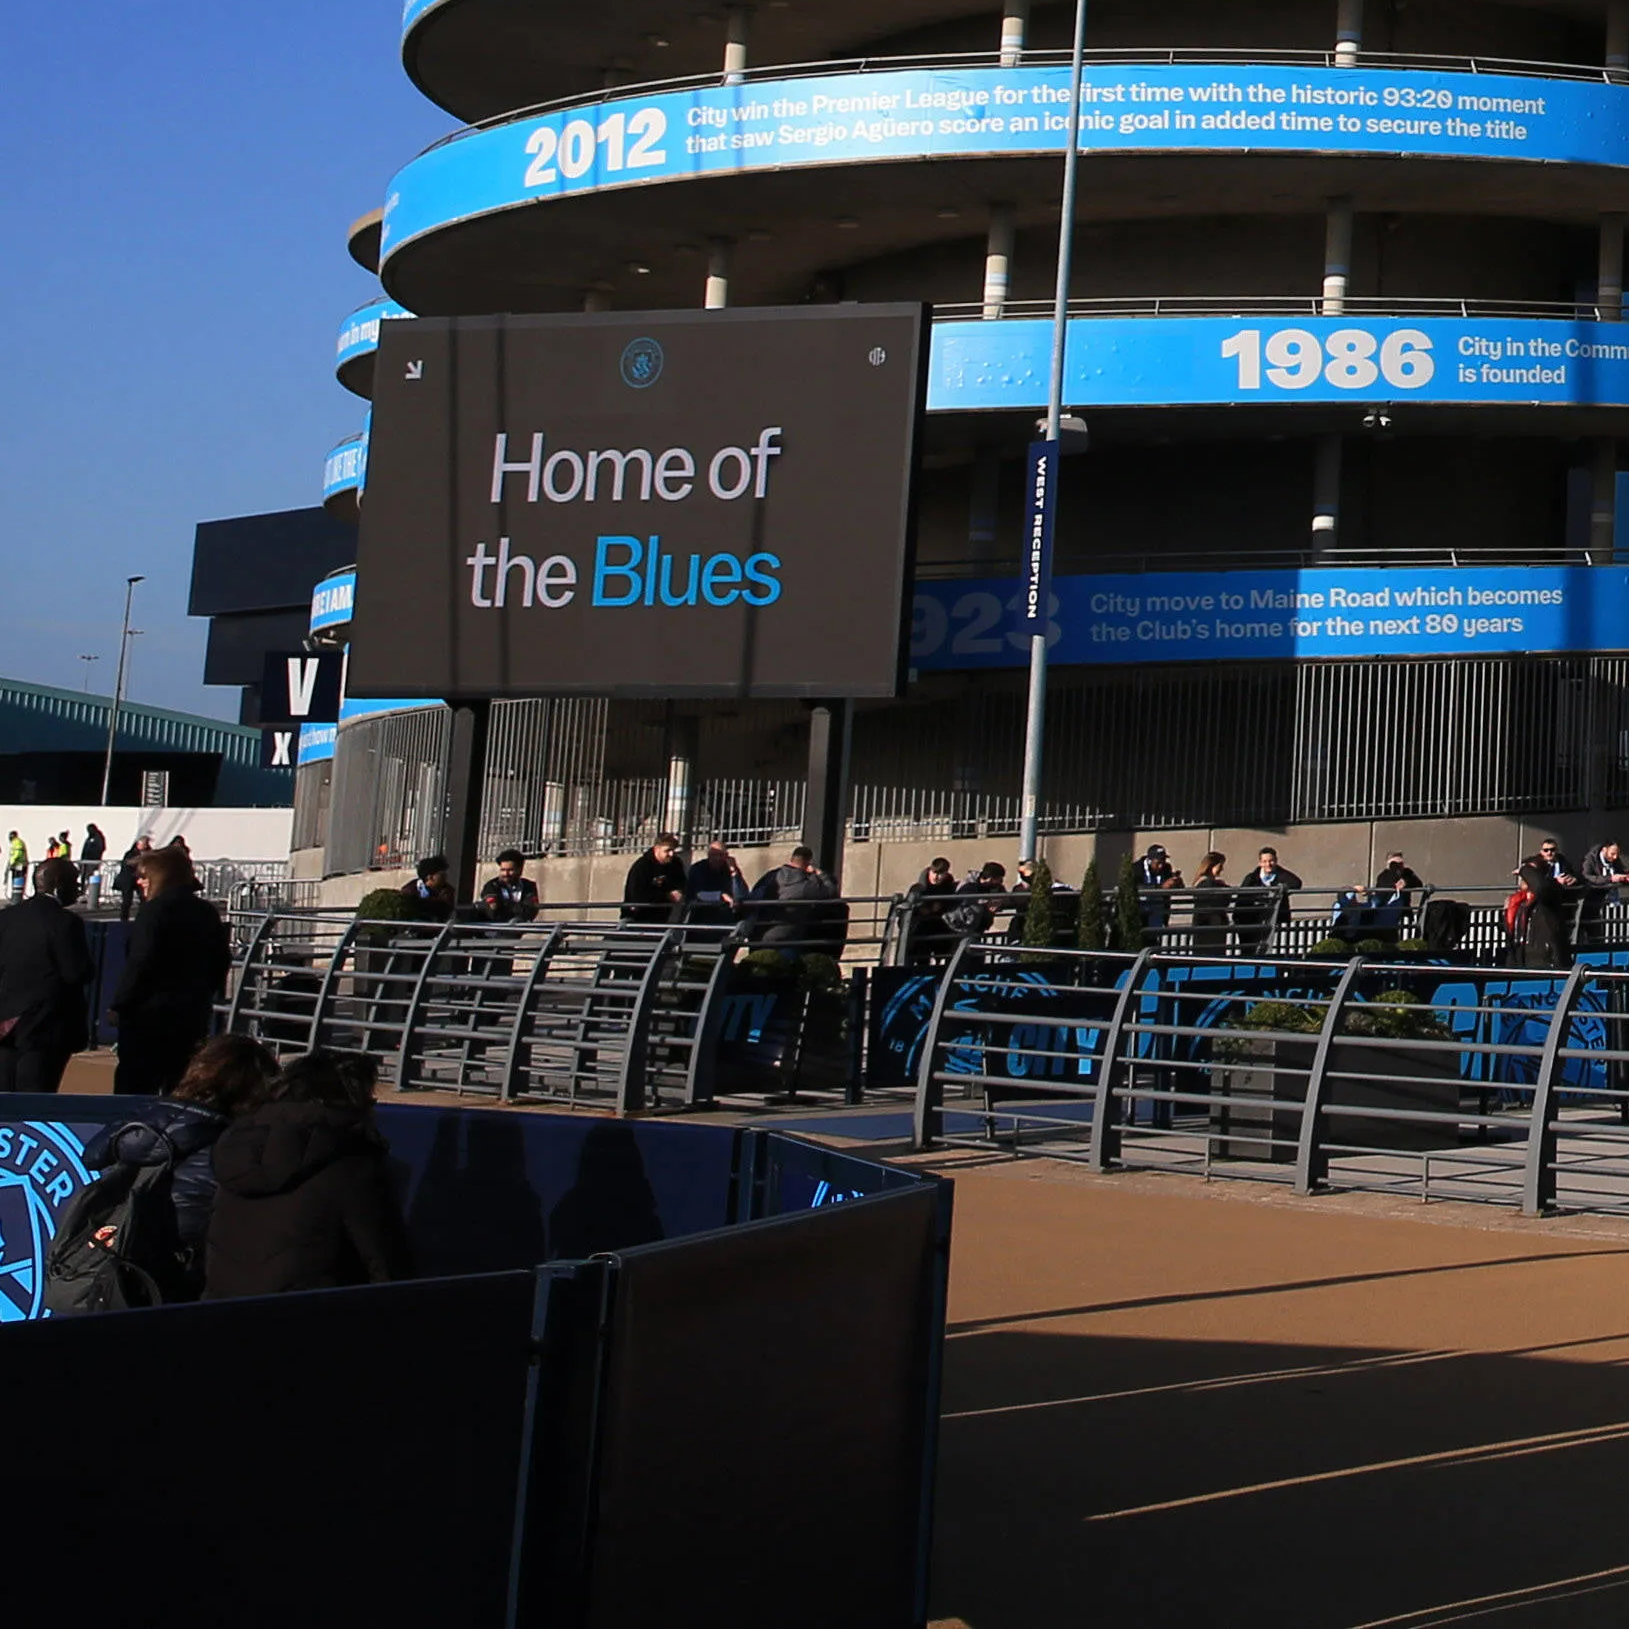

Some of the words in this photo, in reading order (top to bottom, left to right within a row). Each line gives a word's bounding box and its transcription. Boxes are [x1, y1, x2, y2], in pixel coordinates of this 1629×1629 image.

[685, 134, 726, 154] that
[730, 131, 774, 149] saw
[778, 121, 847, 147] Sergio
[851, 117, 934, 142] Agüero
[939, 116, 1004, 135] score
[1009, 114, 1039, 132] an
[1119, 109, 1169, 134] goal
[1174, 109, 1196, 130] in
[1201, 110, 1276, 131] added
[1280, 111, 1333, 132] time
[1337, 113, 1361, 133] to
[1366, 117, 1441, 137] secure
[1446, 117, 1481, 138] the
[1486, 119, 1527, 140] title
[687, 105, 727, 128] City
[731, 101, 768, 123] win
[773, 98, 807, 118] the
[812, 92, 900, 115] Premier
[905, 87, 989, 110] League
[993, 84, 1028, 104] for
[1031, 83, 1072, 103] the
[1129, 82, 1183, 103] time
[1188, 82, 1244, 103] with
[1248, 83, 1286, 104] the
[1291, 84, 1378, 107] historic
[1383, 86, 1452, 110] 93:20
[1457, 92, 1545, 115] moment
[524, 107, 667, 188] 2012
[1221, 328, 1435, 389] 1986
[1458, 335, 1502, 359] City
[1507, 337, 1523, 357] in
[1528, 337, 1562, 357] the
[1458, 365, 1477, 383] is
[1480, 364, 1565, 385] founded
[490, 432, 695, 503] Home
[708, 427, 782, 500] of
[1035, 456, 1047, 509] WEST
[466, 537, 577, 609] the
[592, 535, 782, 607] Blues
[1028, 514, 1043, 618] RECEPTION
[1250, 589, 1324, 609] Maine
[1330, 586, 1390, 608] Road
[1393, 586, 1462, 606] which
[1468, 586, 1563, 605] becomes
[1215, 620, 1284, 638] home
[1288, 617, 1324, 637] for
[1326, 616, 1364, 636] the
[1368, 617, 1420, 635] next
[1425, 614, 1457, 634] 80
[1463, 617, 1523, 638] years
[288, 657, 319, 716] V
